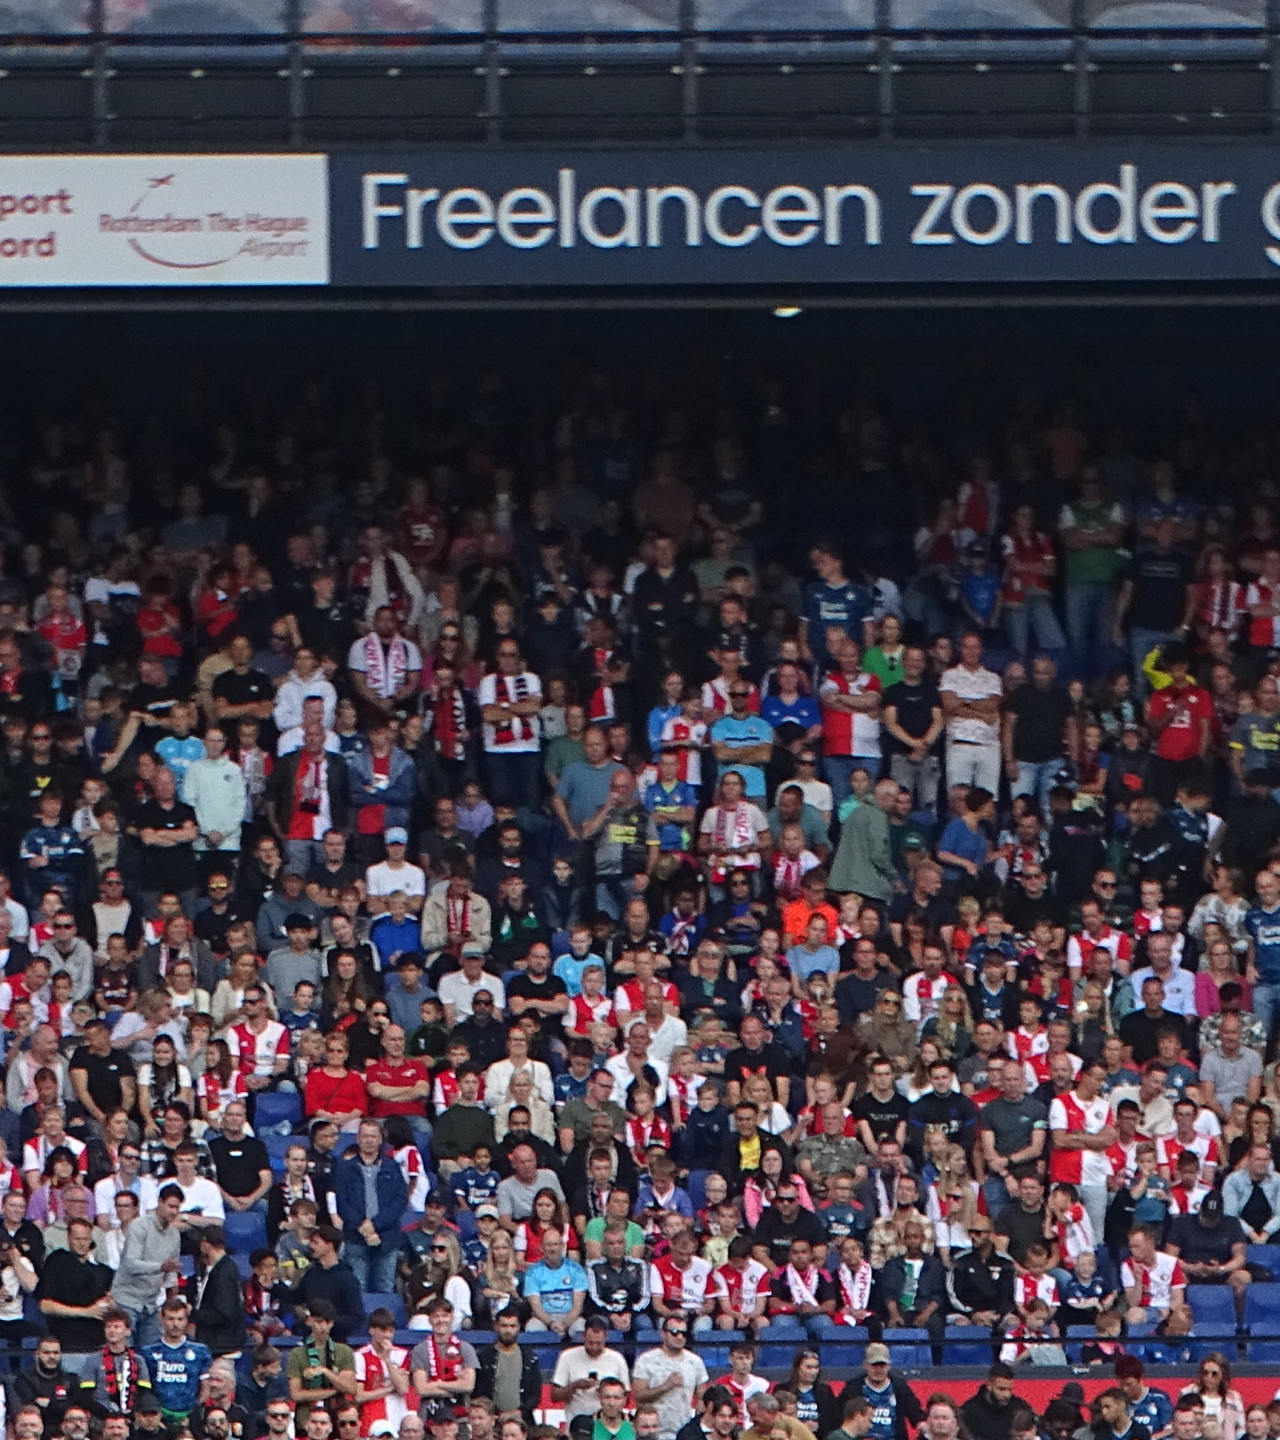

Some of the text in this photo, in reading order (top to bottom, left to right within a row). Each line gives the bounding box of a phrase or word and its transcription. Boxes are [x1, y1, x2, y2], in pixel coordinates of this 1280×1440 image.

[361, 168, 881, 251] Freelancen
[910, 163, 1237, 247] zonder
[99, 211, 308, 237] Rotterdam The Hague
[238, 236, 308, 260] Airport
[158, 1361, 185, 1373] Euro
